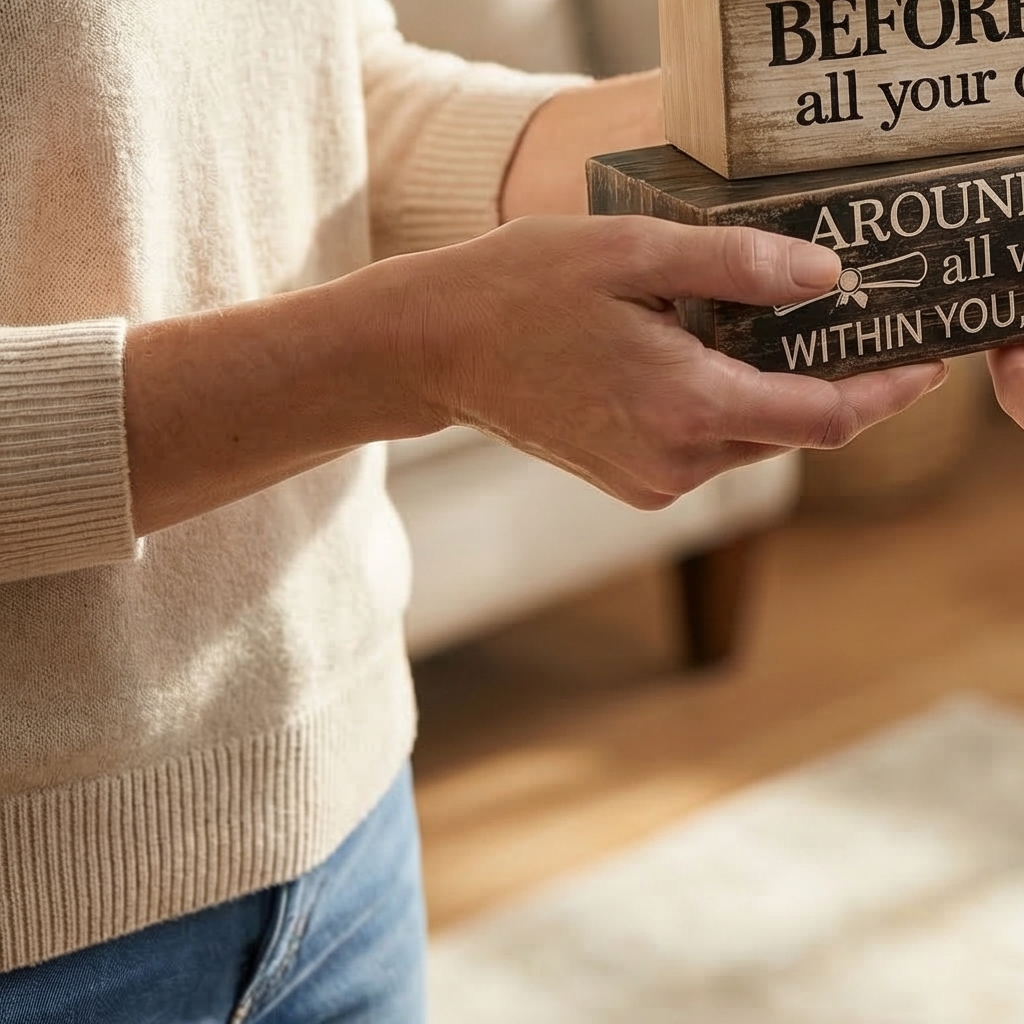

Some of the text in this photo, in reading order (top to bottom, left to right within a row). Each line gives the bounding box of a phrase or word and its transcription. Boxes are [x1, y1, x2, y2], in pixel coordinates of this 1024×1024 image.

[796, 70, 863, 127] all
[878, 68, 995, 131] your
[942, 235, 995, 285] all
[782, 308, 922, 370] WITHIN
